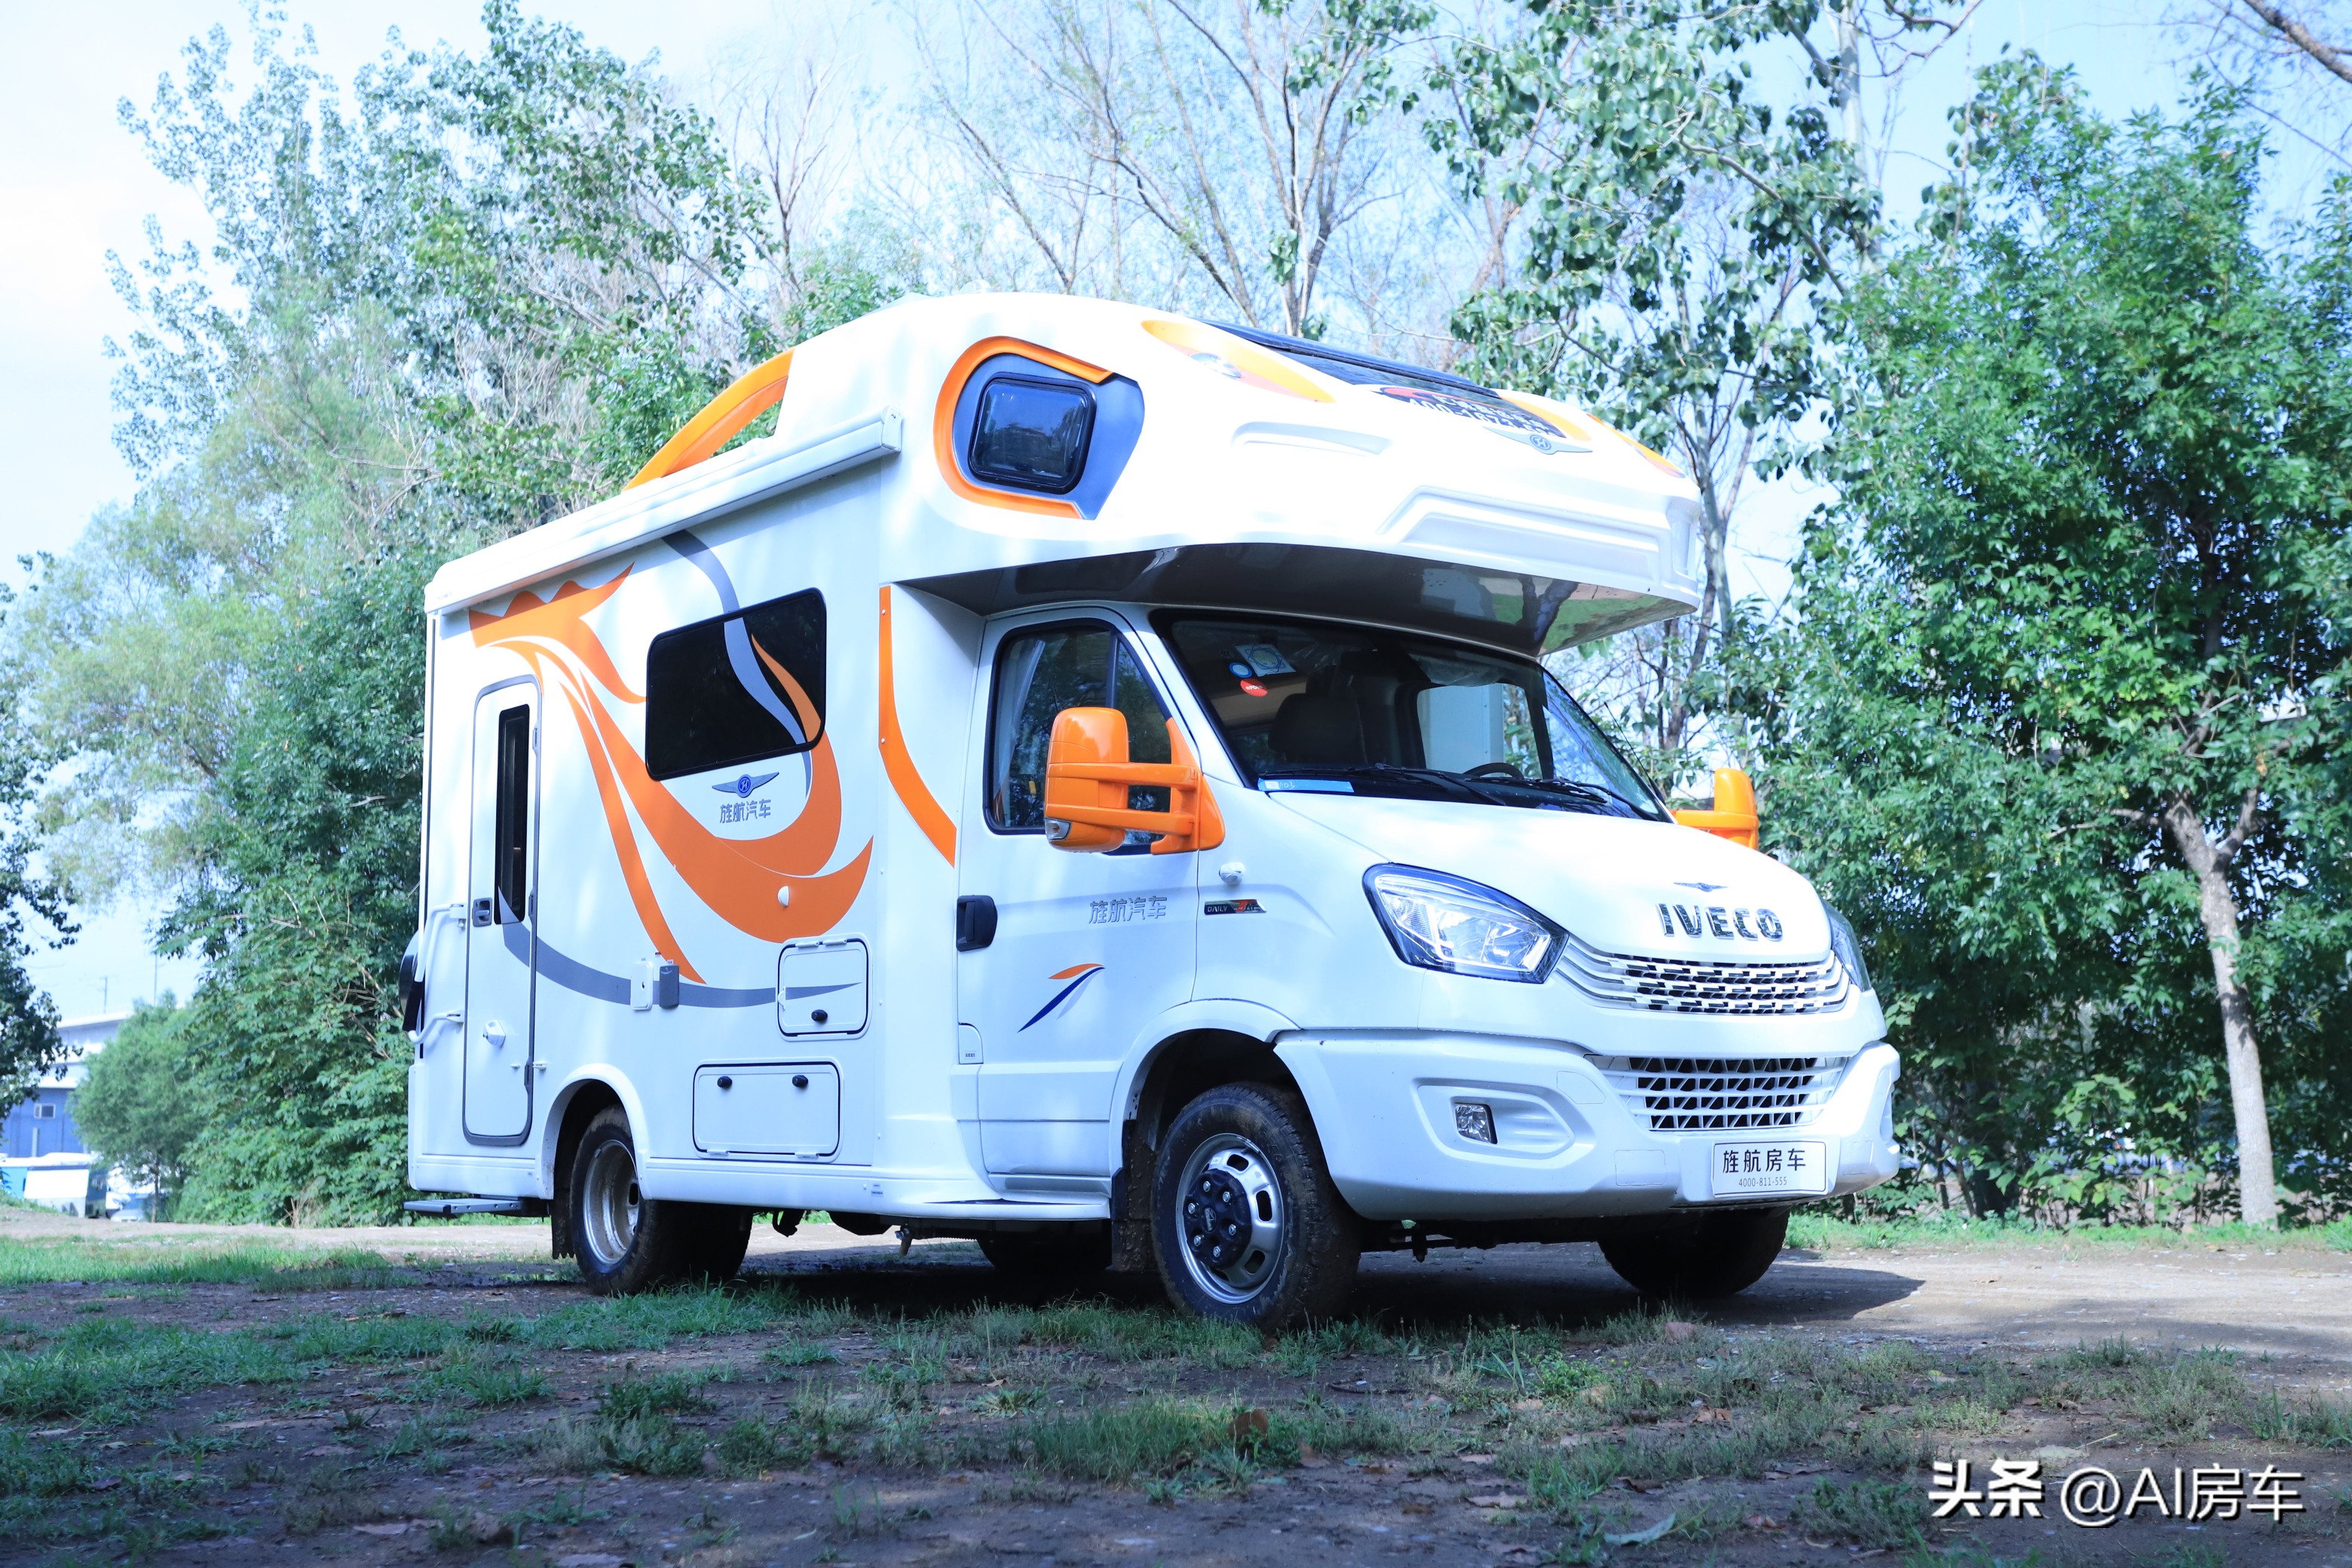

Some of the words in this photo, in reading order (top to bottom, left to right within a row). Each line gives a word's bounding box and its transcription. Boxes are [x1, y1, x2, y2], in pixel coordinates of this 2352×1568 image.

[719, 798, 771, 823] 旌航汽车
[1089, 896, 1168, 924] 旌航汽车
[1656, 903, 1784, 942] IVECO
[1723, 1148, 1806, 1174] 旌航房车
[1738, 1177, 1787, 1187] 4000-811-555
